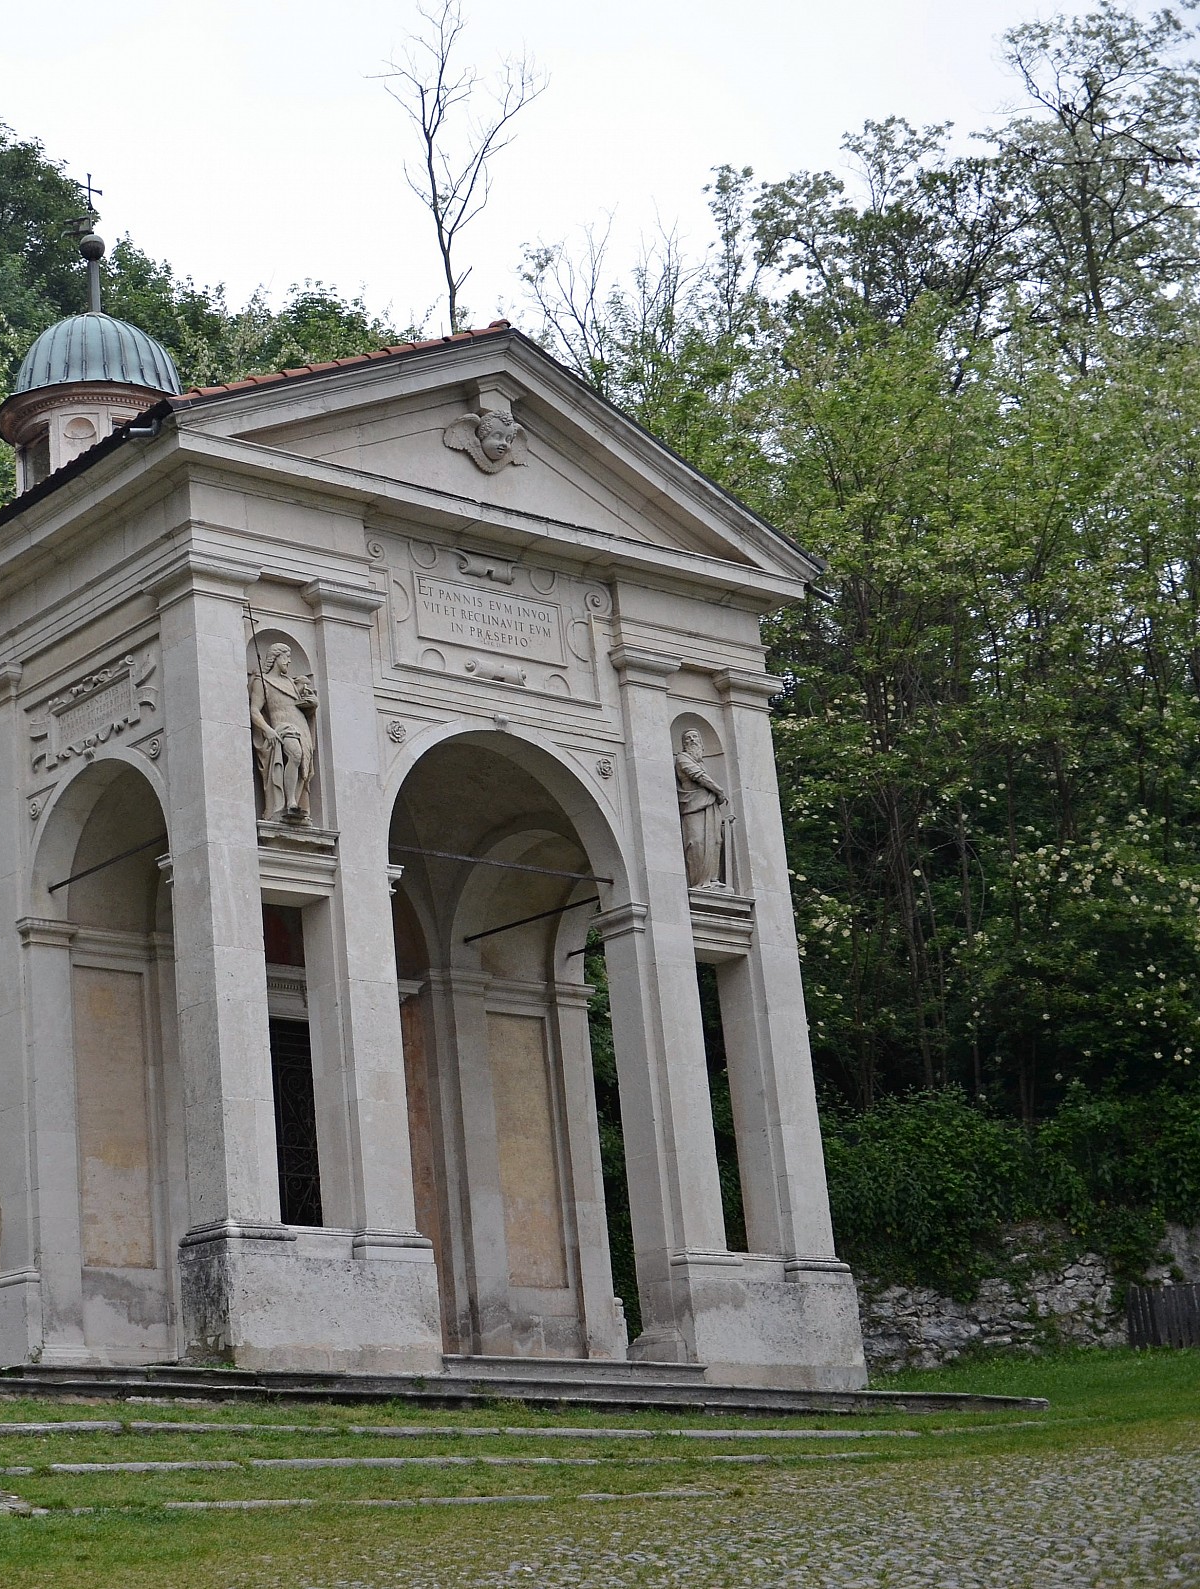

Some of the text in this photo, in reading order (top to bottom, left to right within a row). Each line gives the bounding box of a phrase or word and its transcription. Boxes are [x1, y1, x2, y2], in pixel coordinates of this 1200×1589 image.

[417, 578, 552, 623] ET PANNIS EVM INVOL
[423, 600, 552, 638] VIT ET RECLINAVIT EVM
[450, 622, 464, 634] IN
